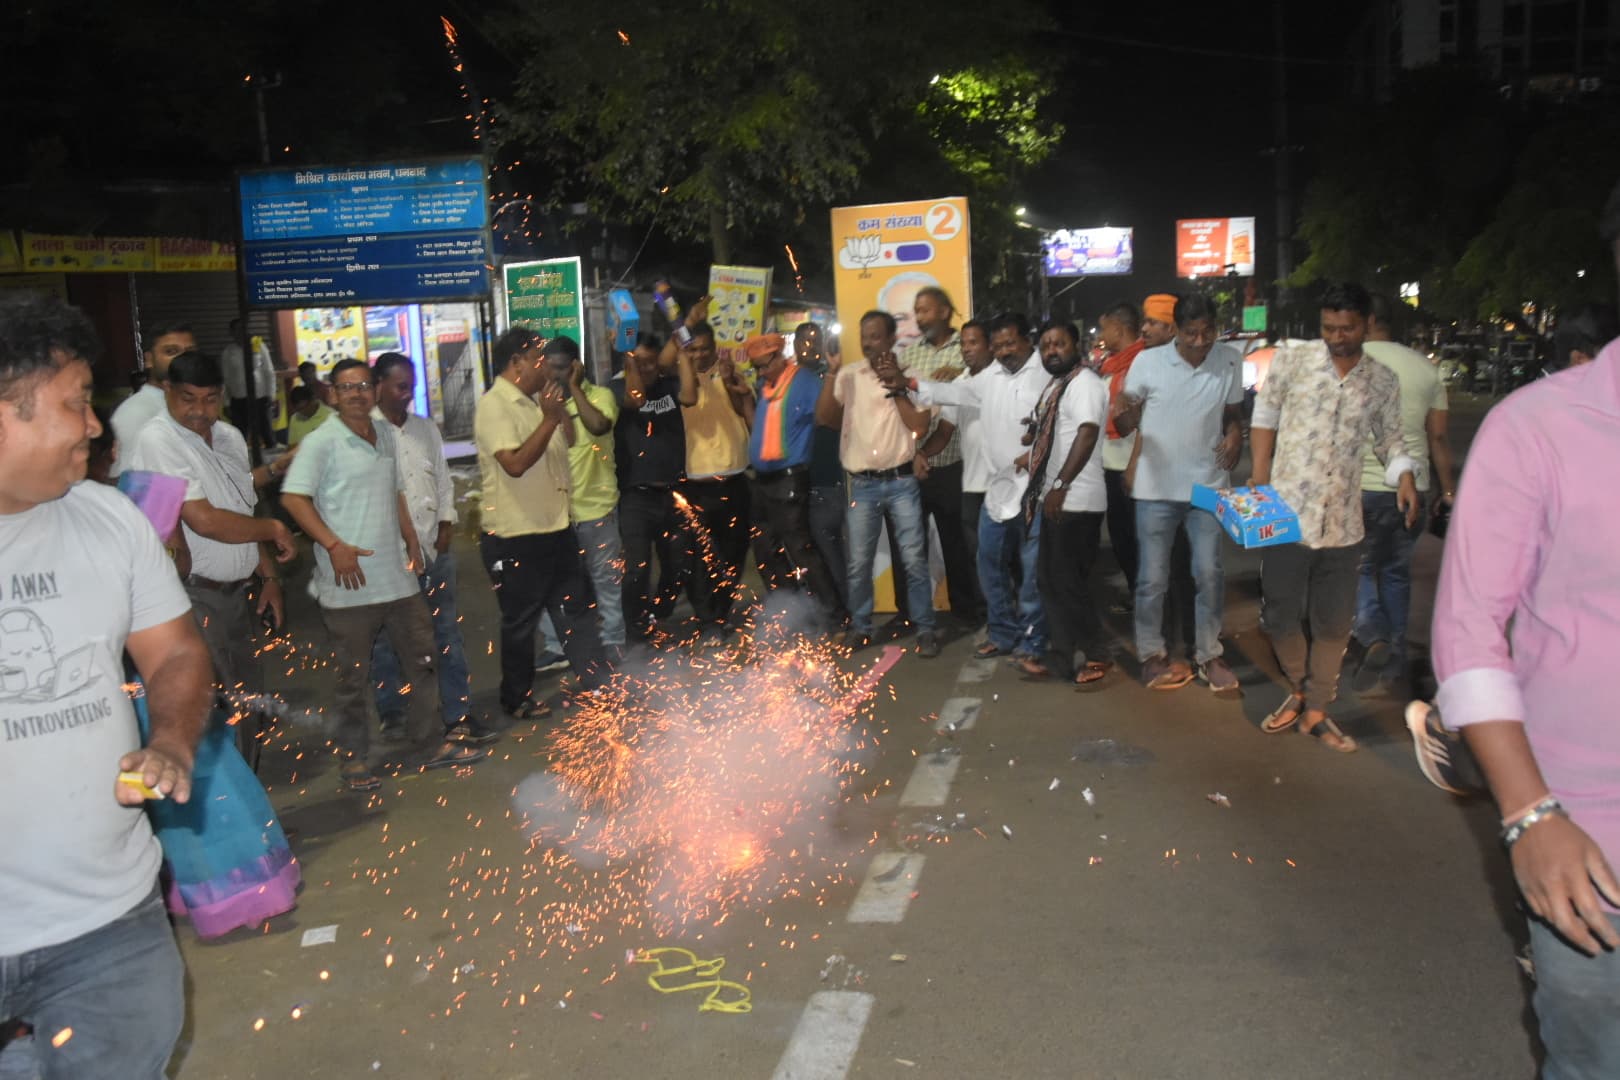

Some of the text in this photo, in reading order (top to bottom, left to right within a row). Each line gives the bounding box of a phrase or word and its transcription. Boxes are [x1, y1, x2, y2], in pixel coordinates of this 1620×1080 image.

[932, 205, 956, 235] 2
[12, 571, 58, 600] AWAY
[3, 697, 112, 741] INTROVERTING
